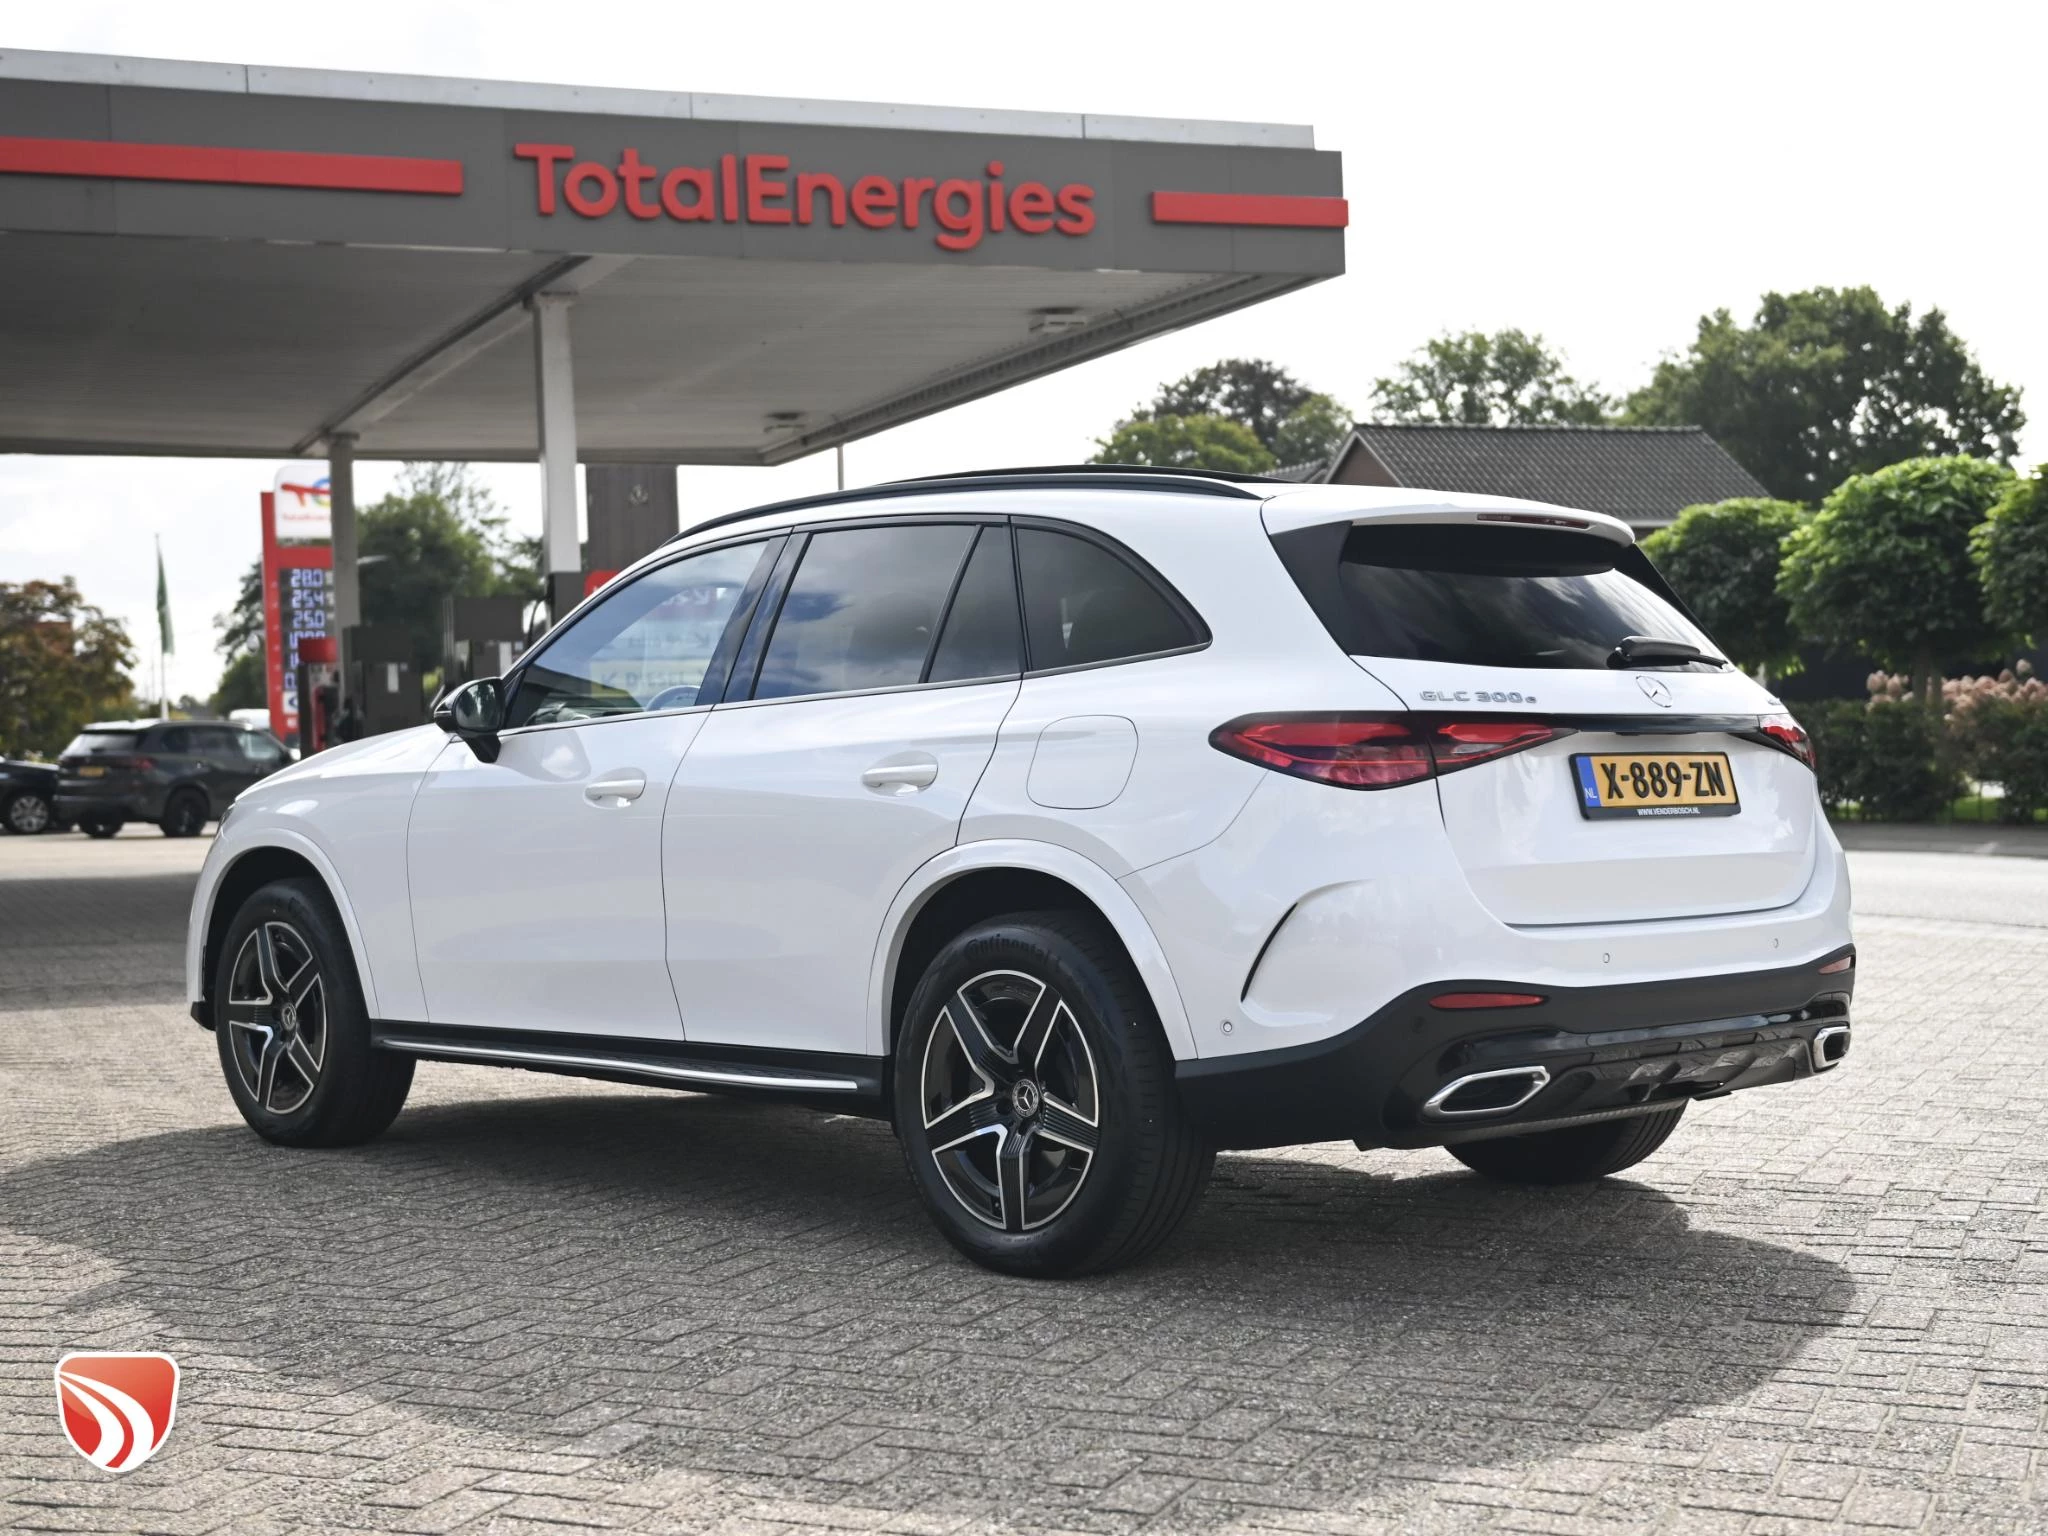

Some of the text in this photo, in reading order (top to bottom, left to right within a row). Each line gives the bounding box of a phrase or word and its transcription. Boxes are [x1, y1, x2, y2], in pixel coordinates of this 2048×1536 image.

[514, 142, 1095, 251] TotalEnergies
[1420, 690, 1471, 703] GLC
[1584, 787, 1598, 799] NL
[1601, 761, 1727, 800] X-889-ZN
